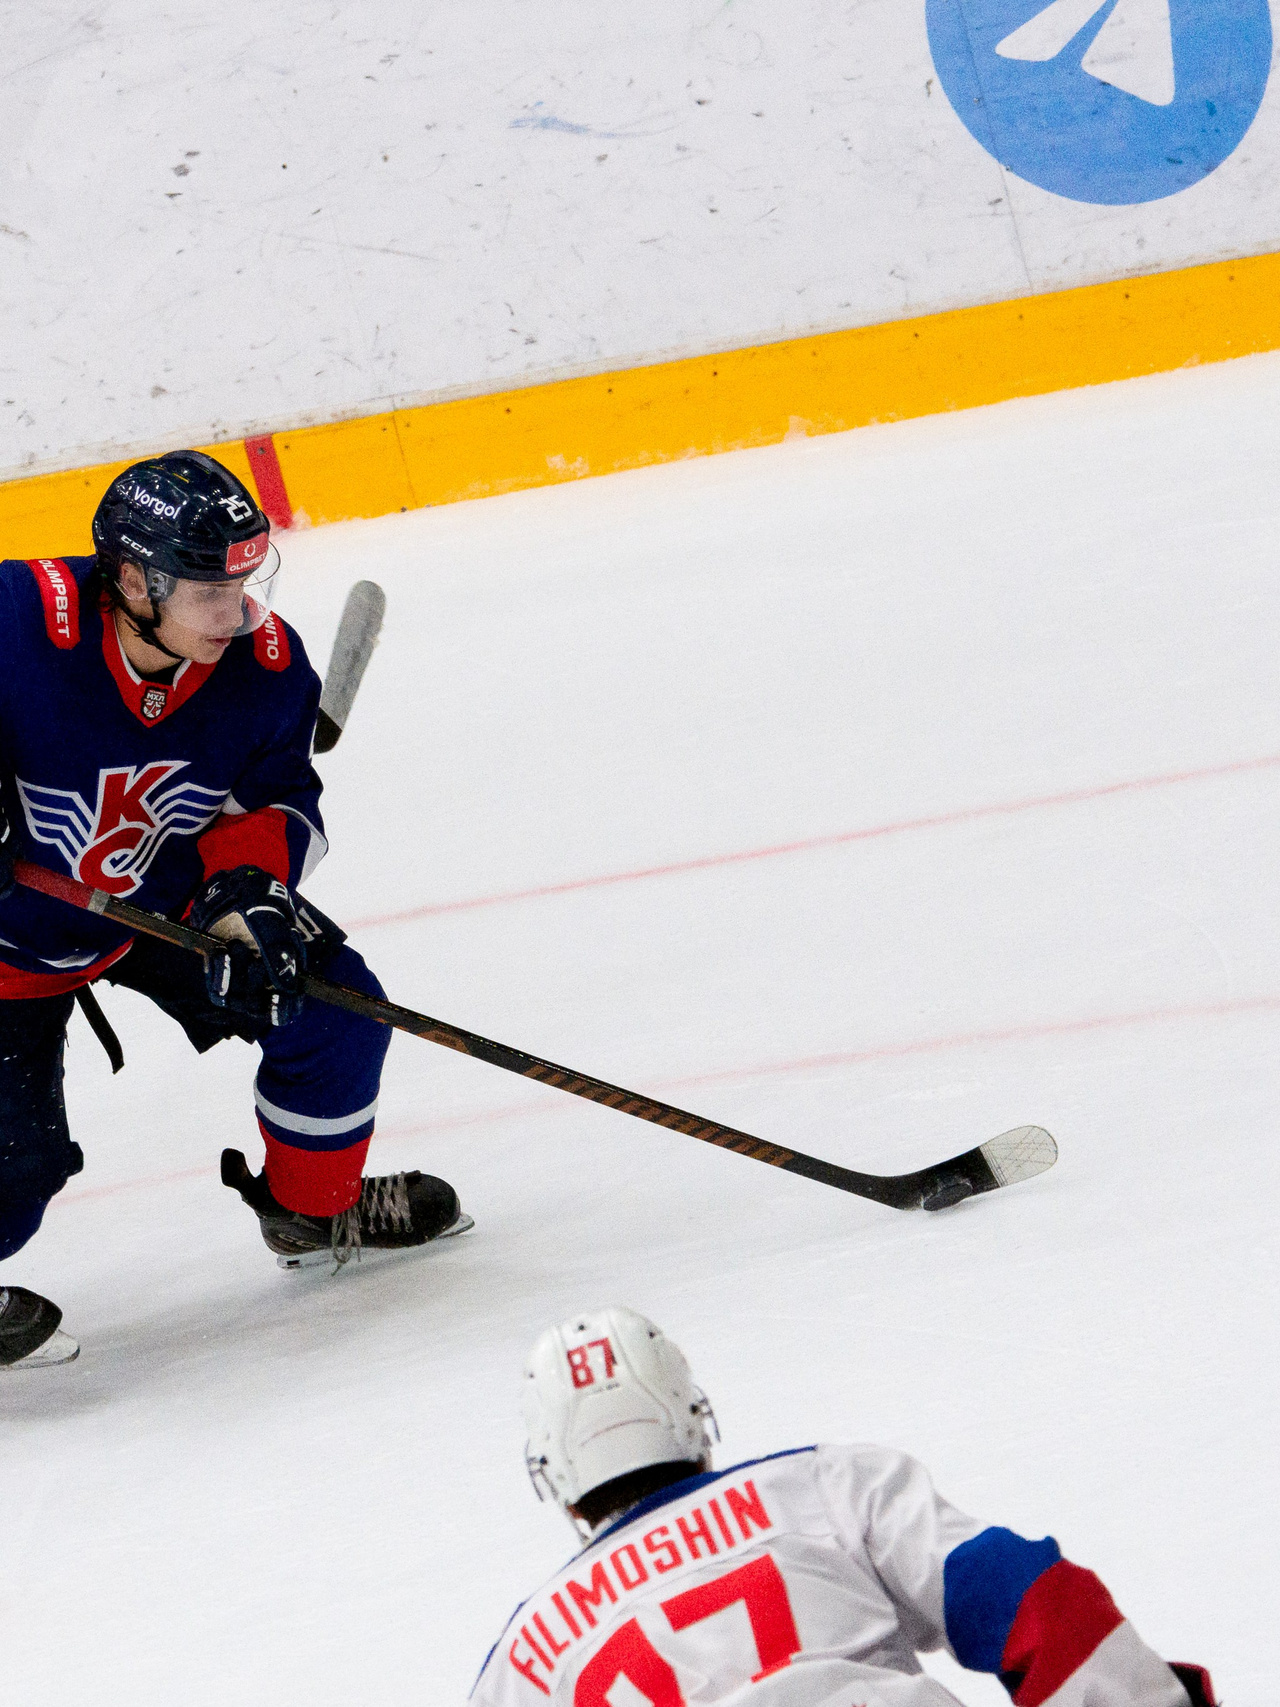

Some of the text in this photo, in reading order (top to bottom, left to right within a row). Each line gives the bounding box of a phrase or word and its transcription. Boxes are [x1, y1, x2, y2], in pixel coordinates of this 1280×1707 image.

[133, 486, 182, 519] Vorgol
[218, 494, 253, 523] 25
[120, 534, 155, 557] CCM
[229, 553, 267, 572] OLIMPBET
[38, 559, 70, 639] OLIMPBET
[566, 1337, 615, 1389] 87
[509, 1480, 773, 1697] FILIMOSHIN
